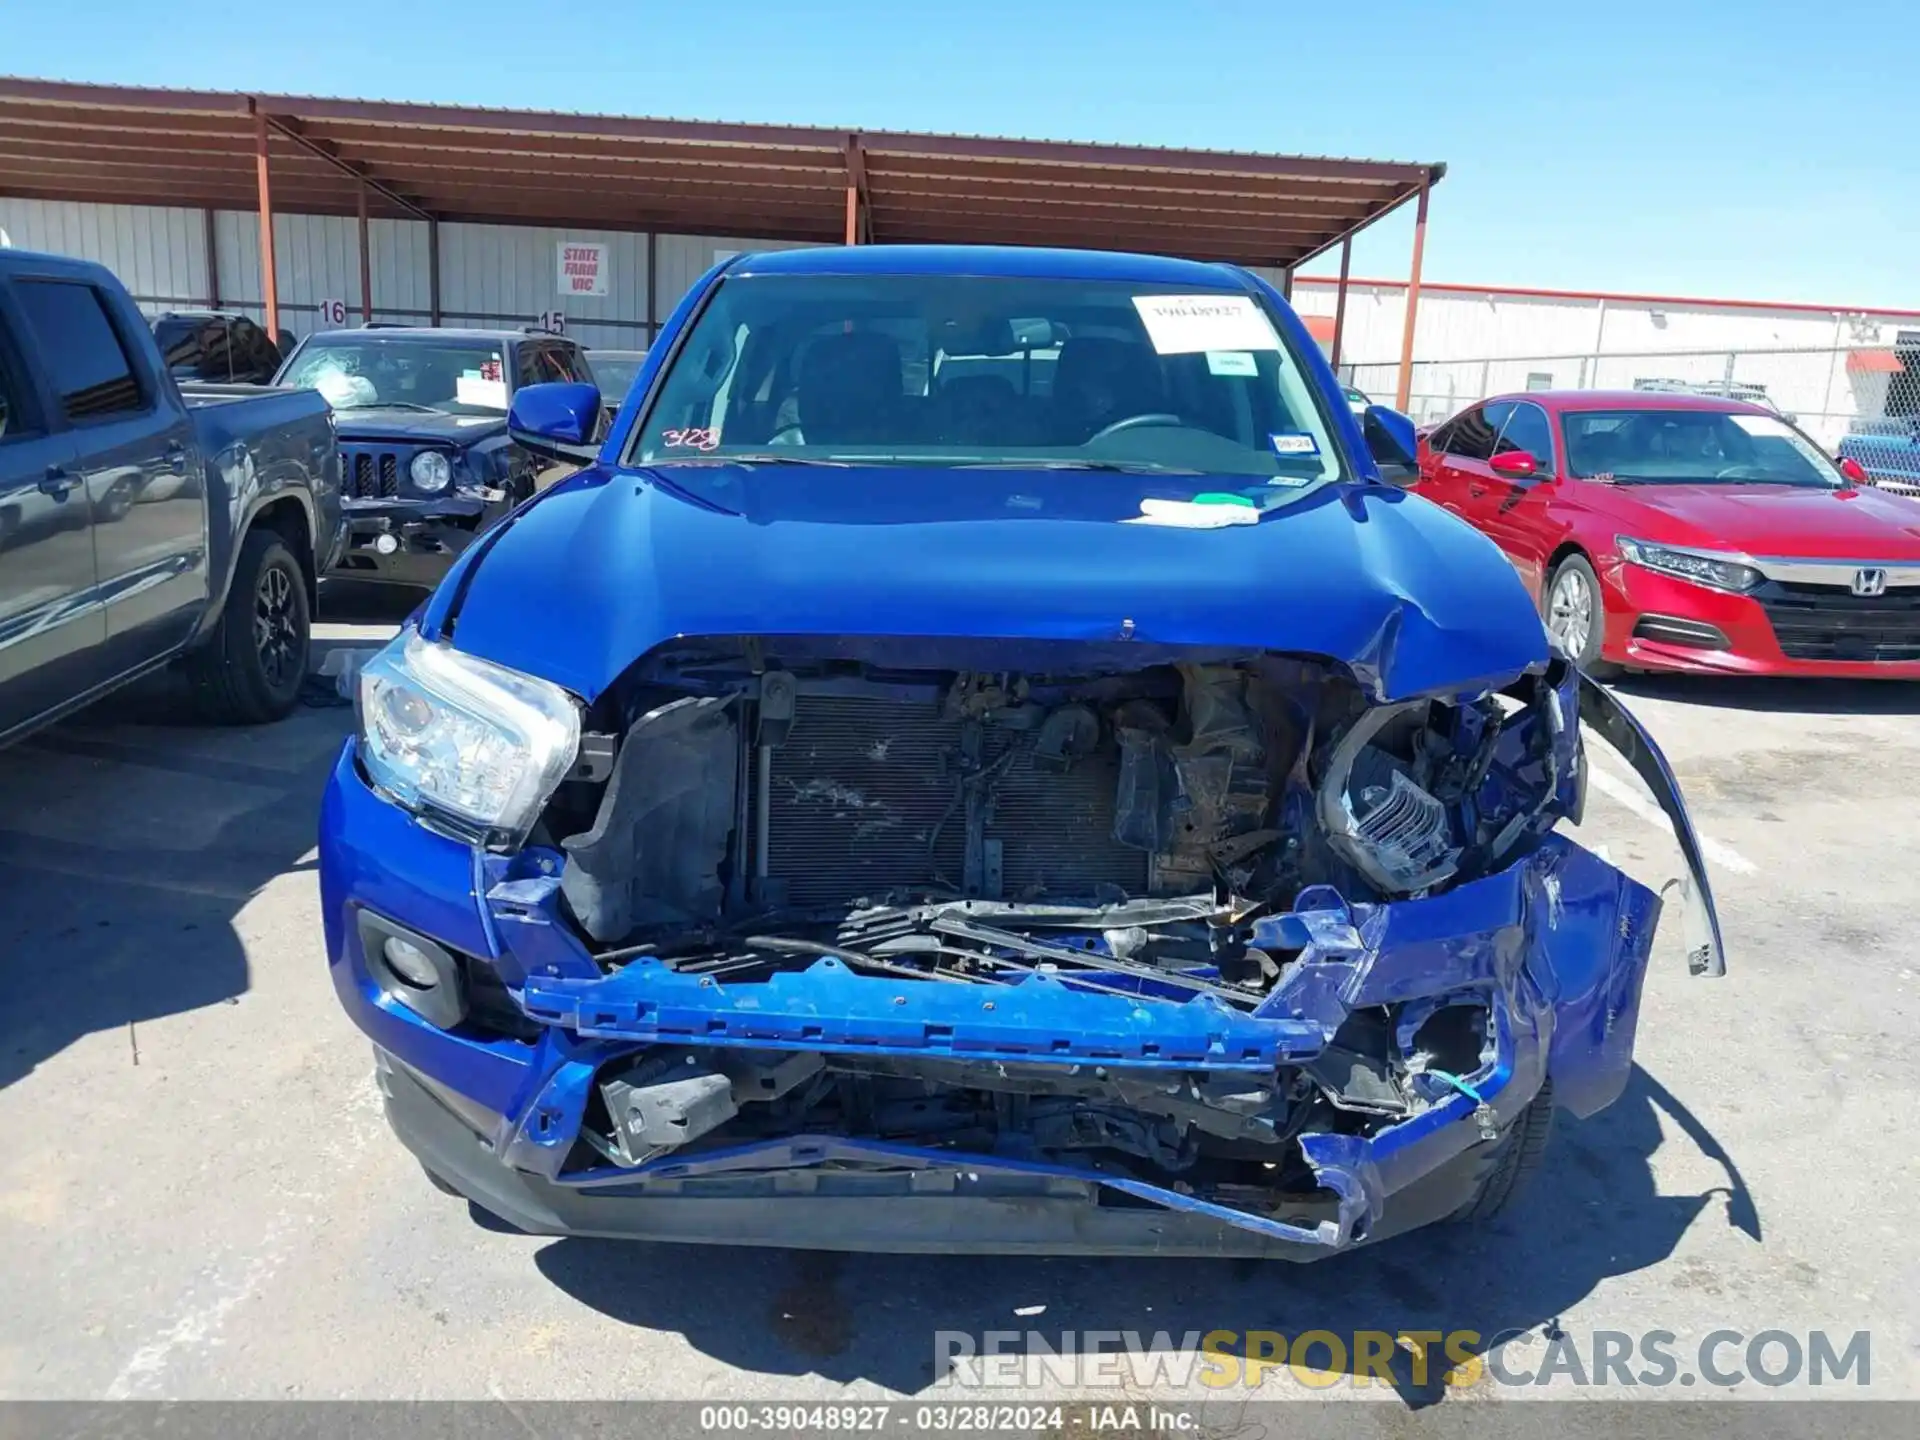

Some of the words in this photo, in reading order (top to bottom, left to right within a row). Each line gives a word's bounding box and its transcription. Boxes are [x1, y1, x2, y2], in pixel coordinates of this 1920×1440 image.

[564, 248, 600, 261] STATE
[564, 262, 598, 276] FARM
[320, 300, 345, 323] 16
[541, 311, 564, 335] 15
